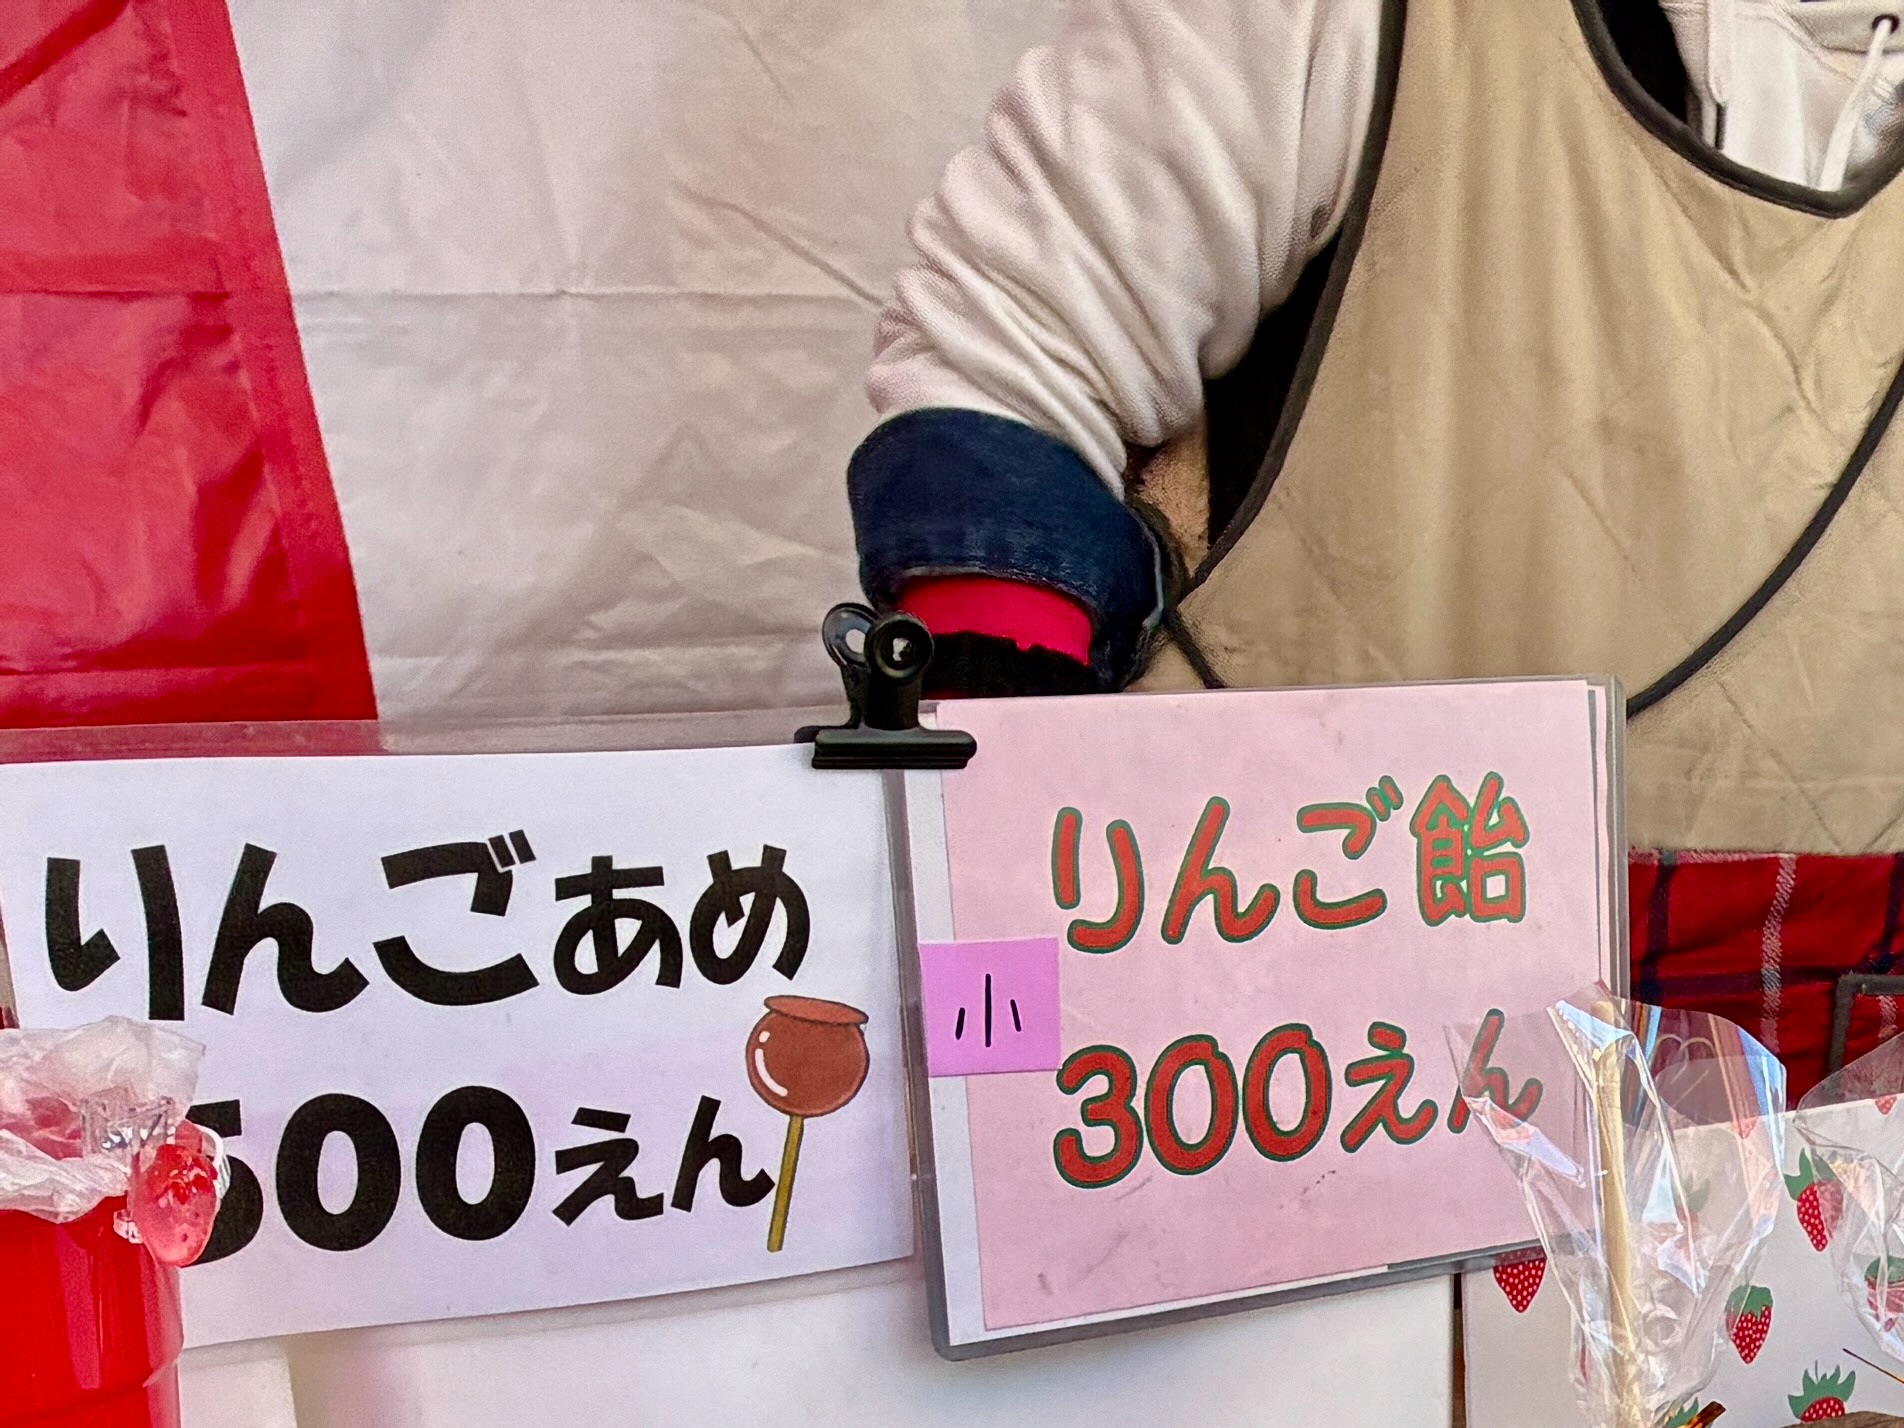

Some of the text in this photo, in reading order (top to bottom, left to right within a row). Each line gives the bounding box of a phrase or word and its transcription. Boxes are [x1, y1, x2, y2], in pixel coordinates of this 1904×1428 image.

[45, 829, 811, 1021] りんごあめ
[1051, 771, 1531, 954] りんご飴
[954, 972, 1022, 1048] 小
[1053, 1008, 1543, 1189] 300えん
